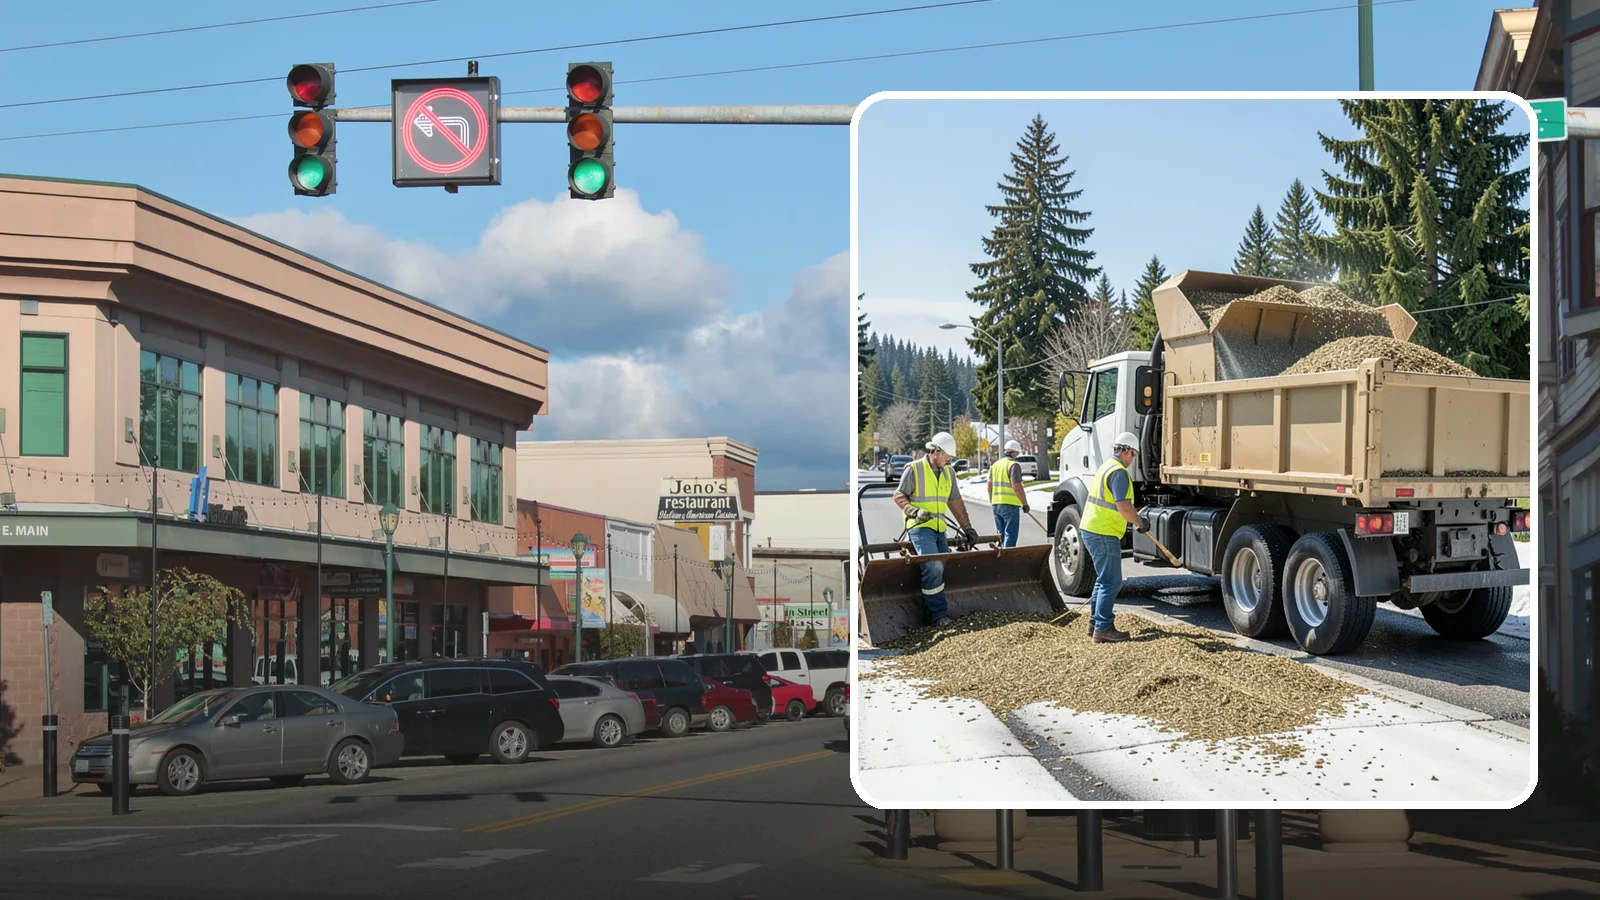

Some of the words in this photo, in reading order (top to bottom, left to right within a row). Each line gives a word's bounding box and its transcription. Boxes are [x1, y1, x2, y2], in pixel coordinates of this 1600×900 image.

[669, 480, 728, 495] Jeno's
[665, 496, 731, 509] restaurant
[686, 510, 714, 519] American
[715, 510, 738, 519] Cuisine
[2, 525, 13, 536] E.
[15, 525, 49, 537] MAIN
[797, 607, 829, 617] Street
[791, 619, 824, 628] lass
